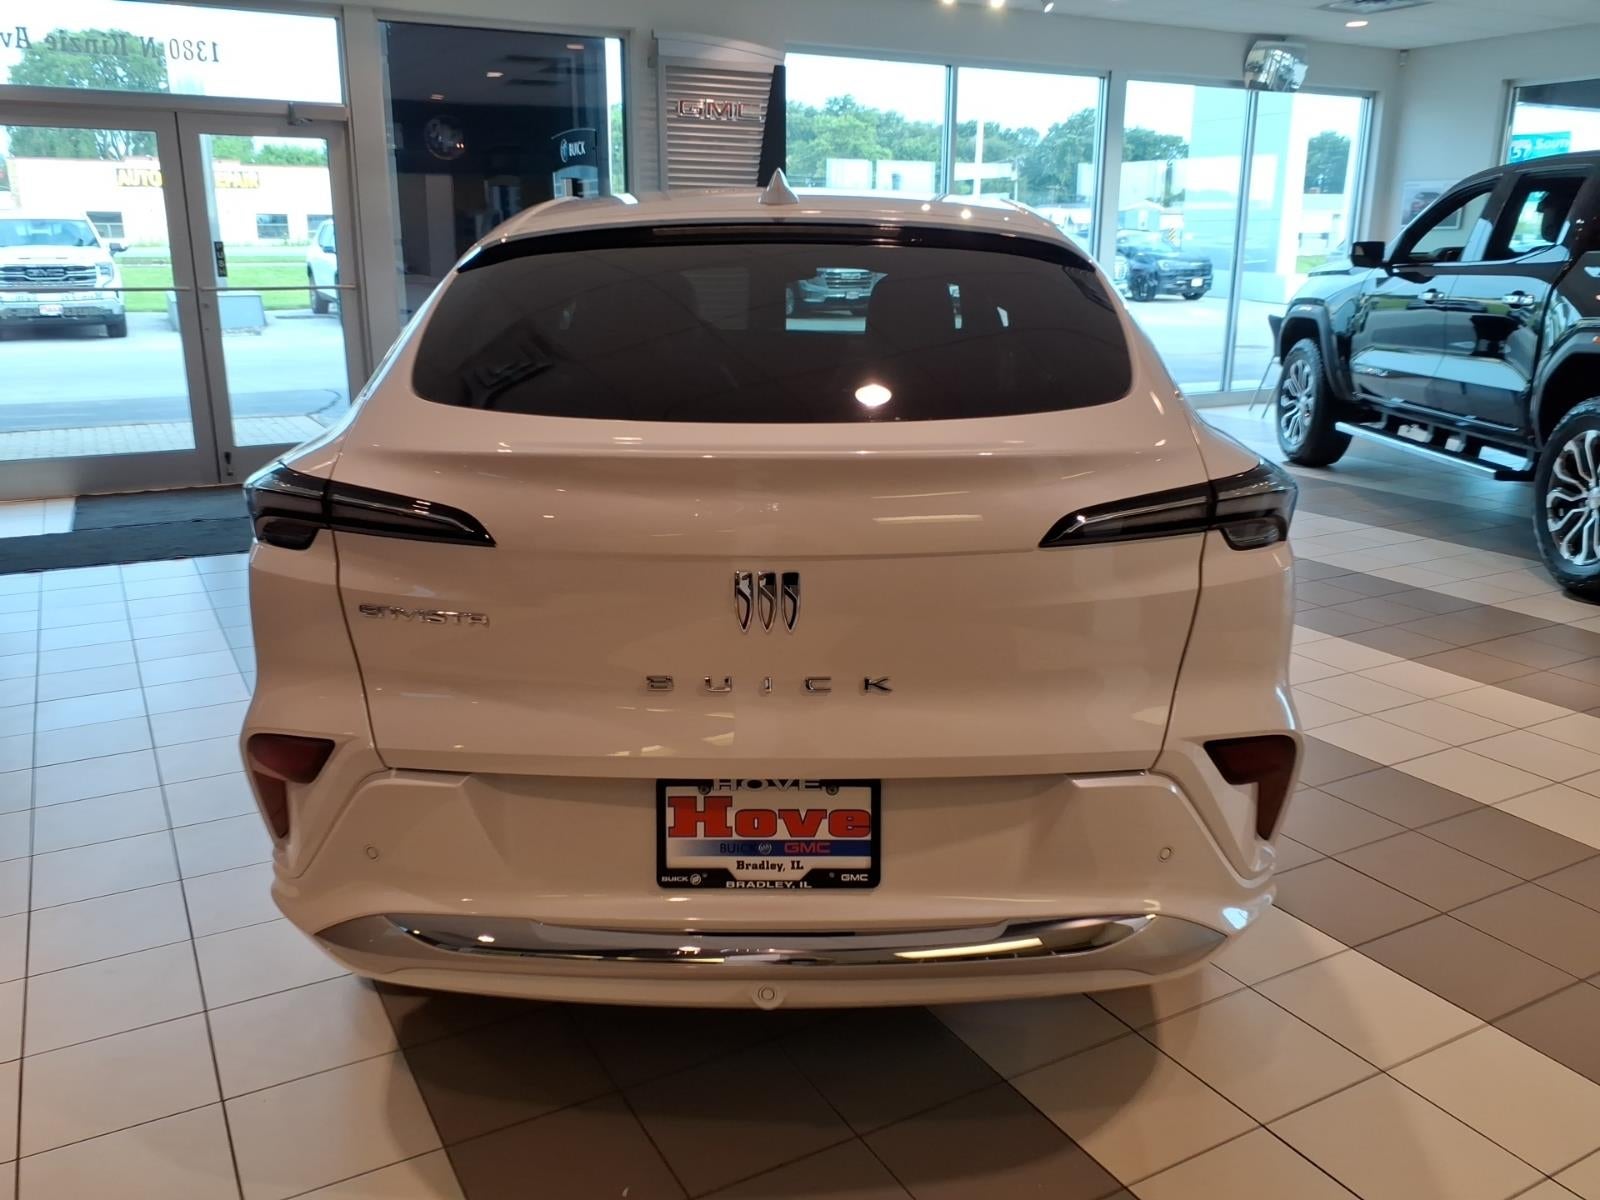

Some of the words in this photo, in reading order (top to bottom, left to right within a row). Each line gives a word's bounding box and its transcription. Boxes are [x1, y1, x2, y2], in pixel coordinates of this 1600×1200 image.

[677, 98, 768, 122] GMC
[569, 140, 586, 156] BUICK
[115, 168, 163, 187] AUTO
[358, 604, 490, 627] ENVISTA
[645, 674, 893, 694] BUICK
[713, 779, 823, 792] HOVE
[667, 796, 872, 838] Hove
[784, 842, 831, 853] GMC
[735, 860, 786, 872] Bradley,
[790, 860, 804, 871] IL
[661, 875, 689, 883] BUICK
[840, 873, 869, 882] GMC
[800, 881, 812, 889] IL
